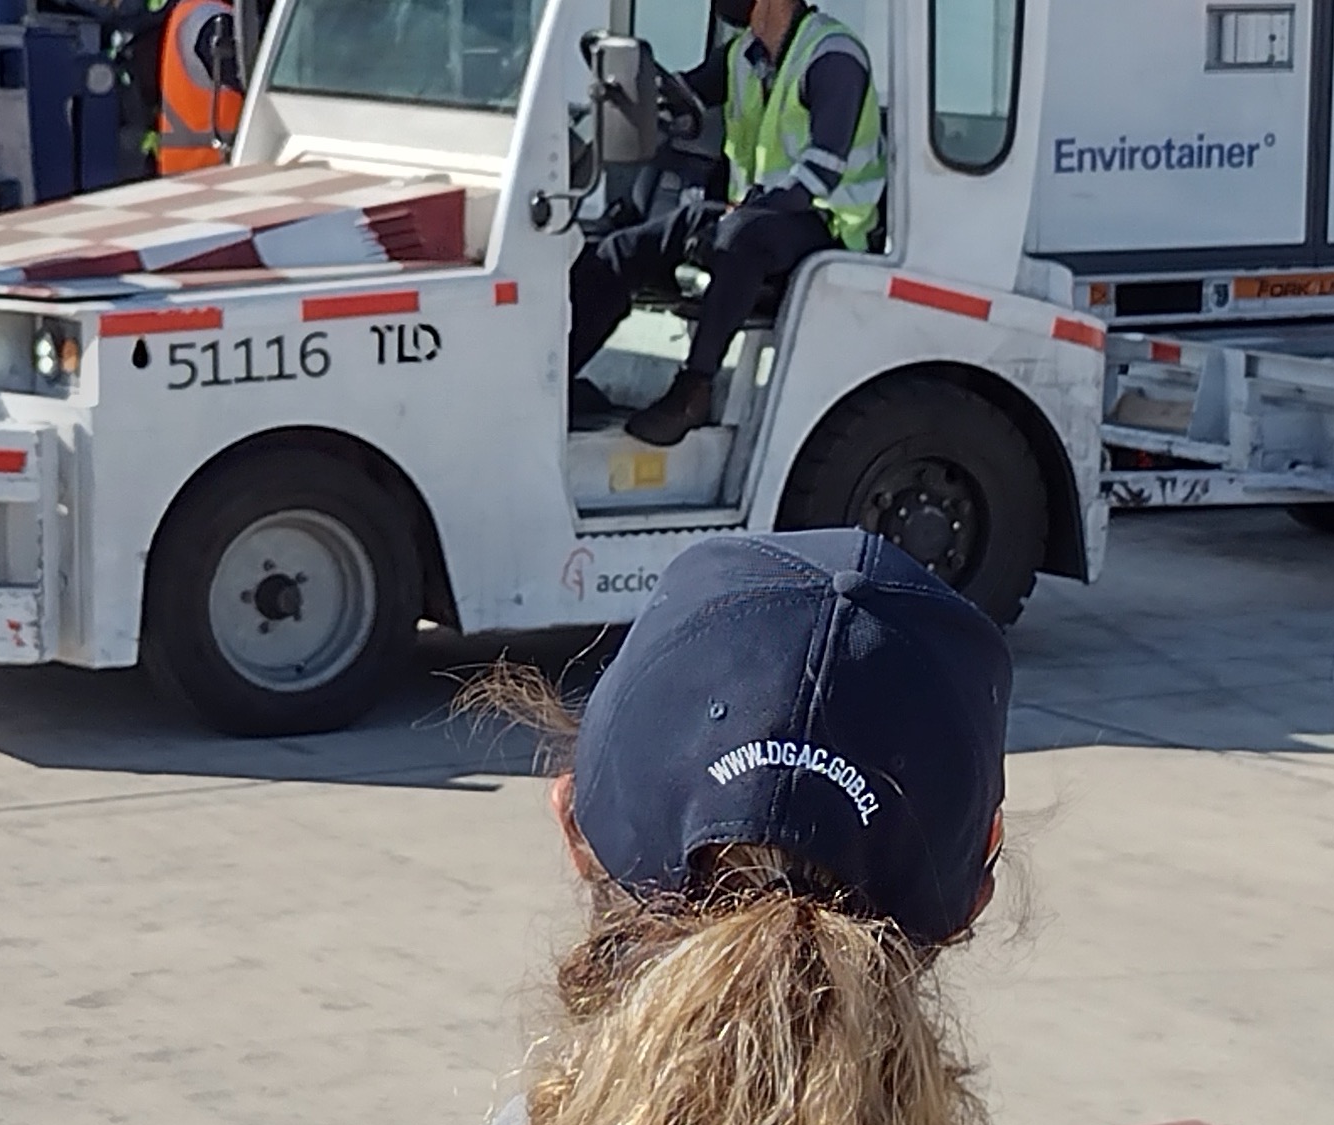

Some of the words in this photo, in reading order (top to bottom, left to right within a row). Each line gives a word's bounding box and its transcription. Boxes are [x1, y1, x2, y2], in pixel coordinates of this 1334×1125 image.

[167, 331, 331, 390] 51116
[370, 323, 442, 364] TLD
[708, 741, 879, 826] WWW.DGAC.GOB.CL
